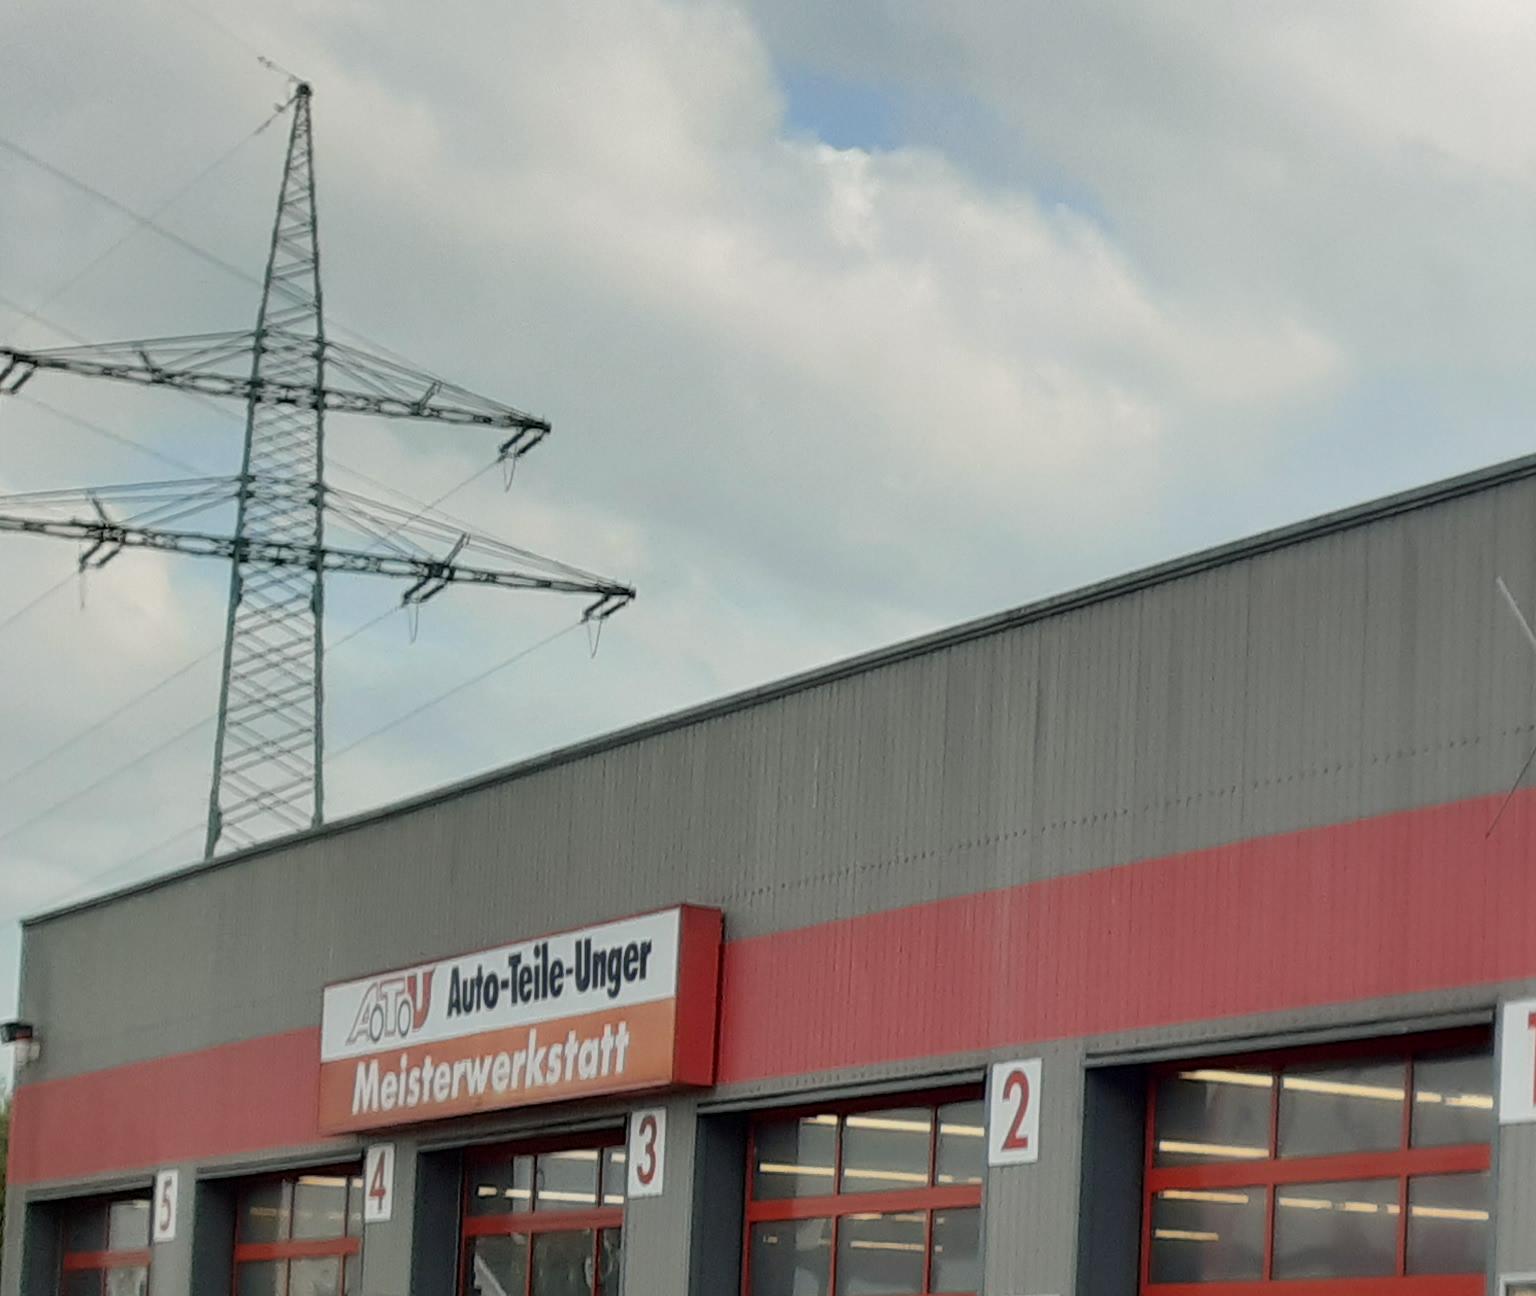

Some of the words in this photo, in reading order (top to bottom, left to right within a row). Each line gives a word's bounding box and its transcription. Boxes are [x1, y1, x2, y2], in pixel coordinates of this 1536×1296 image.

[446, 937, 653, 1019] Auto-Teile-Unger
[351, 1021, 631, 1116] Meisterwerkstatt
[1001, 1069, 1031, 1151] 2
[368, 1151, 387, 1210] 4
[635, 1116, 660, 1187] 3
[159, 1180, 173, 1233] 5
